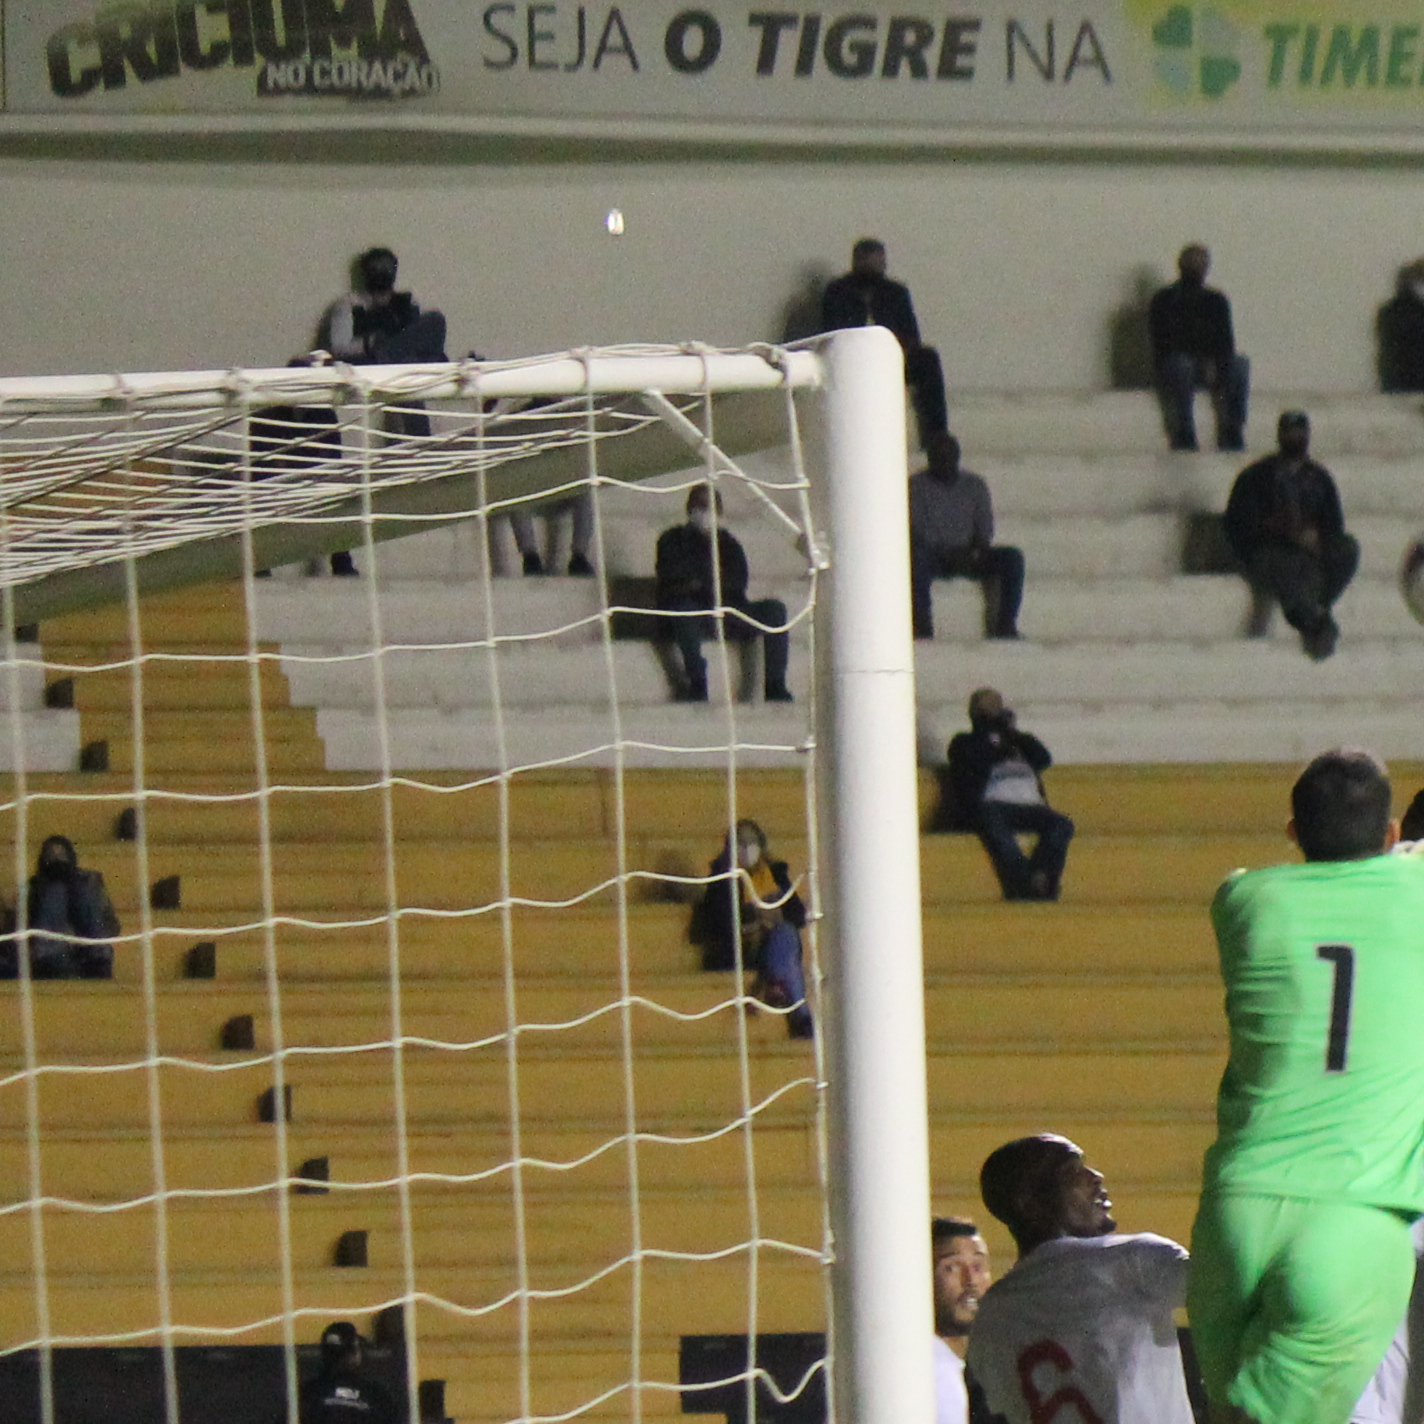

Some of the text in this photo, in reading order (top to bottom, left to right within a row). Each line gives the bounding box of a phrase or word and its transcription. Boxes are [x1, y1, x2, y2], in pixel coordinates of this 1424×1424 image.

[265, 62, 305, 91] NO
[482, 4, 1114, 84] SEJA O TIGRE NA
[1315, 944, 1355, 1074] 1
